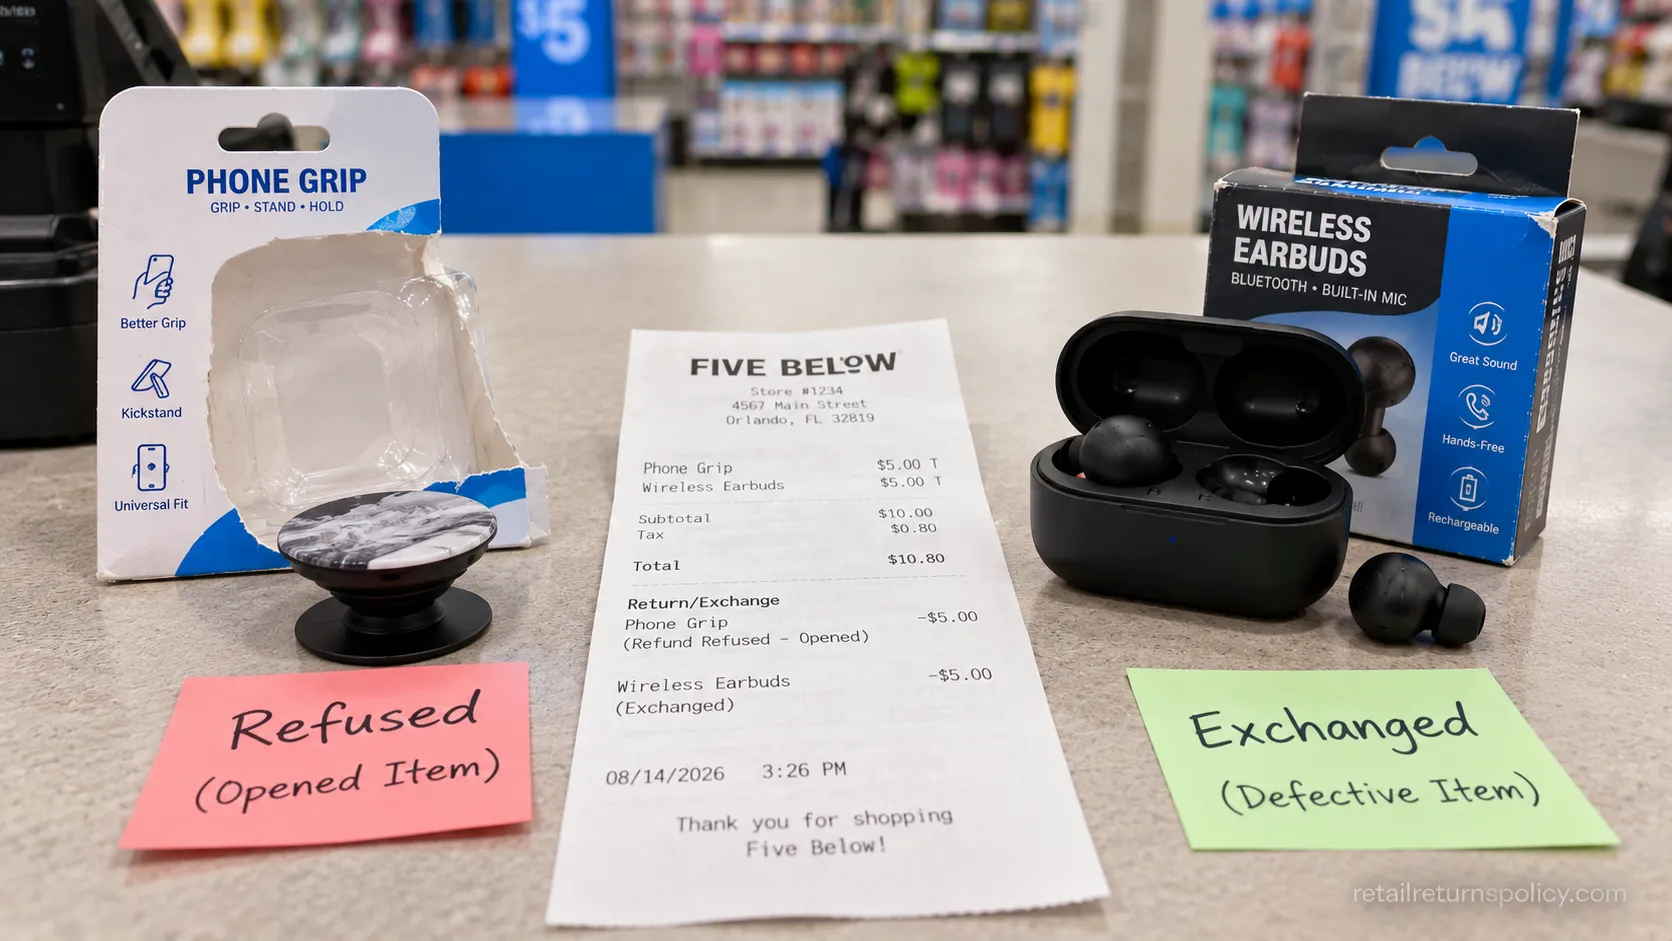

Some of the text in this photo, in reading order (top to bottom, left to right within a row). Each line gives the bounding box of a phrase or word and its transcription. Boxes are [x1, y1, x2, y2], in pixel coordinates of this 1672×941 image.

[186, 167, 367, 195] PHONE GRIP
[210, 200, 344, 214] GRIP STAND HOLD
[1236, 203, 1372, 244] WIRELESS
[1232, 236, 1368, 278] EARBUDS
[1231, 271, 1407, 307] BLUETOOTH BUILT-IN MIC
[120, 316, 187, 331] Better Grip
[690, 351, 897, 377] FIVE BELOW
[1449, 351, 1518, 371] Great Sound
[750, 385, 843, 396] Store #1234
[121, 406, 182, 419] Kickstand
[731, 399, 867, 411] 4567 Main Street
[726, 413, 875, 426] Orlando, FL 32819
[1442, 433, 1505, 454] Hands-Free
[643, 457, 938, 476] Phone Grip $5.00 T
[642, 475, 942, 493] Wireless Earbuds $5.00 T
[114, 498, 189, 512] Universal Fit
[638, 507, 933, 525] Subtotal $10.00
[1428, 511, 1500, 535] Rechargeable
[637, 522, 937, 540] Tax $0.80
[633, 553, 945, 572] Total $10.80
[627, 595, 780, 610] Return/Exchange
[625, 610, 978, 631] Phone Grip -$5.00
[623, 635, 693, 652] (Refund
[701, 632, 770, 648] Refused
[799, 629, 869, 646] Opened)
[617, 667, 993, 693] Wireless Earbuds -$5.00
[615, 697, 734, 717] (Exchanged)
[230, 688, 482, 751] Refused
[1188, 700, 1479, 756] Exchanged
[195, 747, 500, 815] (Opened Item)
[605, 761, 847, 786] 08/14/2026 3:26 PM
[1221, 771, 1540, 816] (Defective Item)
[677, 809, 954, 834] Thank you for shopping
[746, 835, 885, 858] Five Below!
